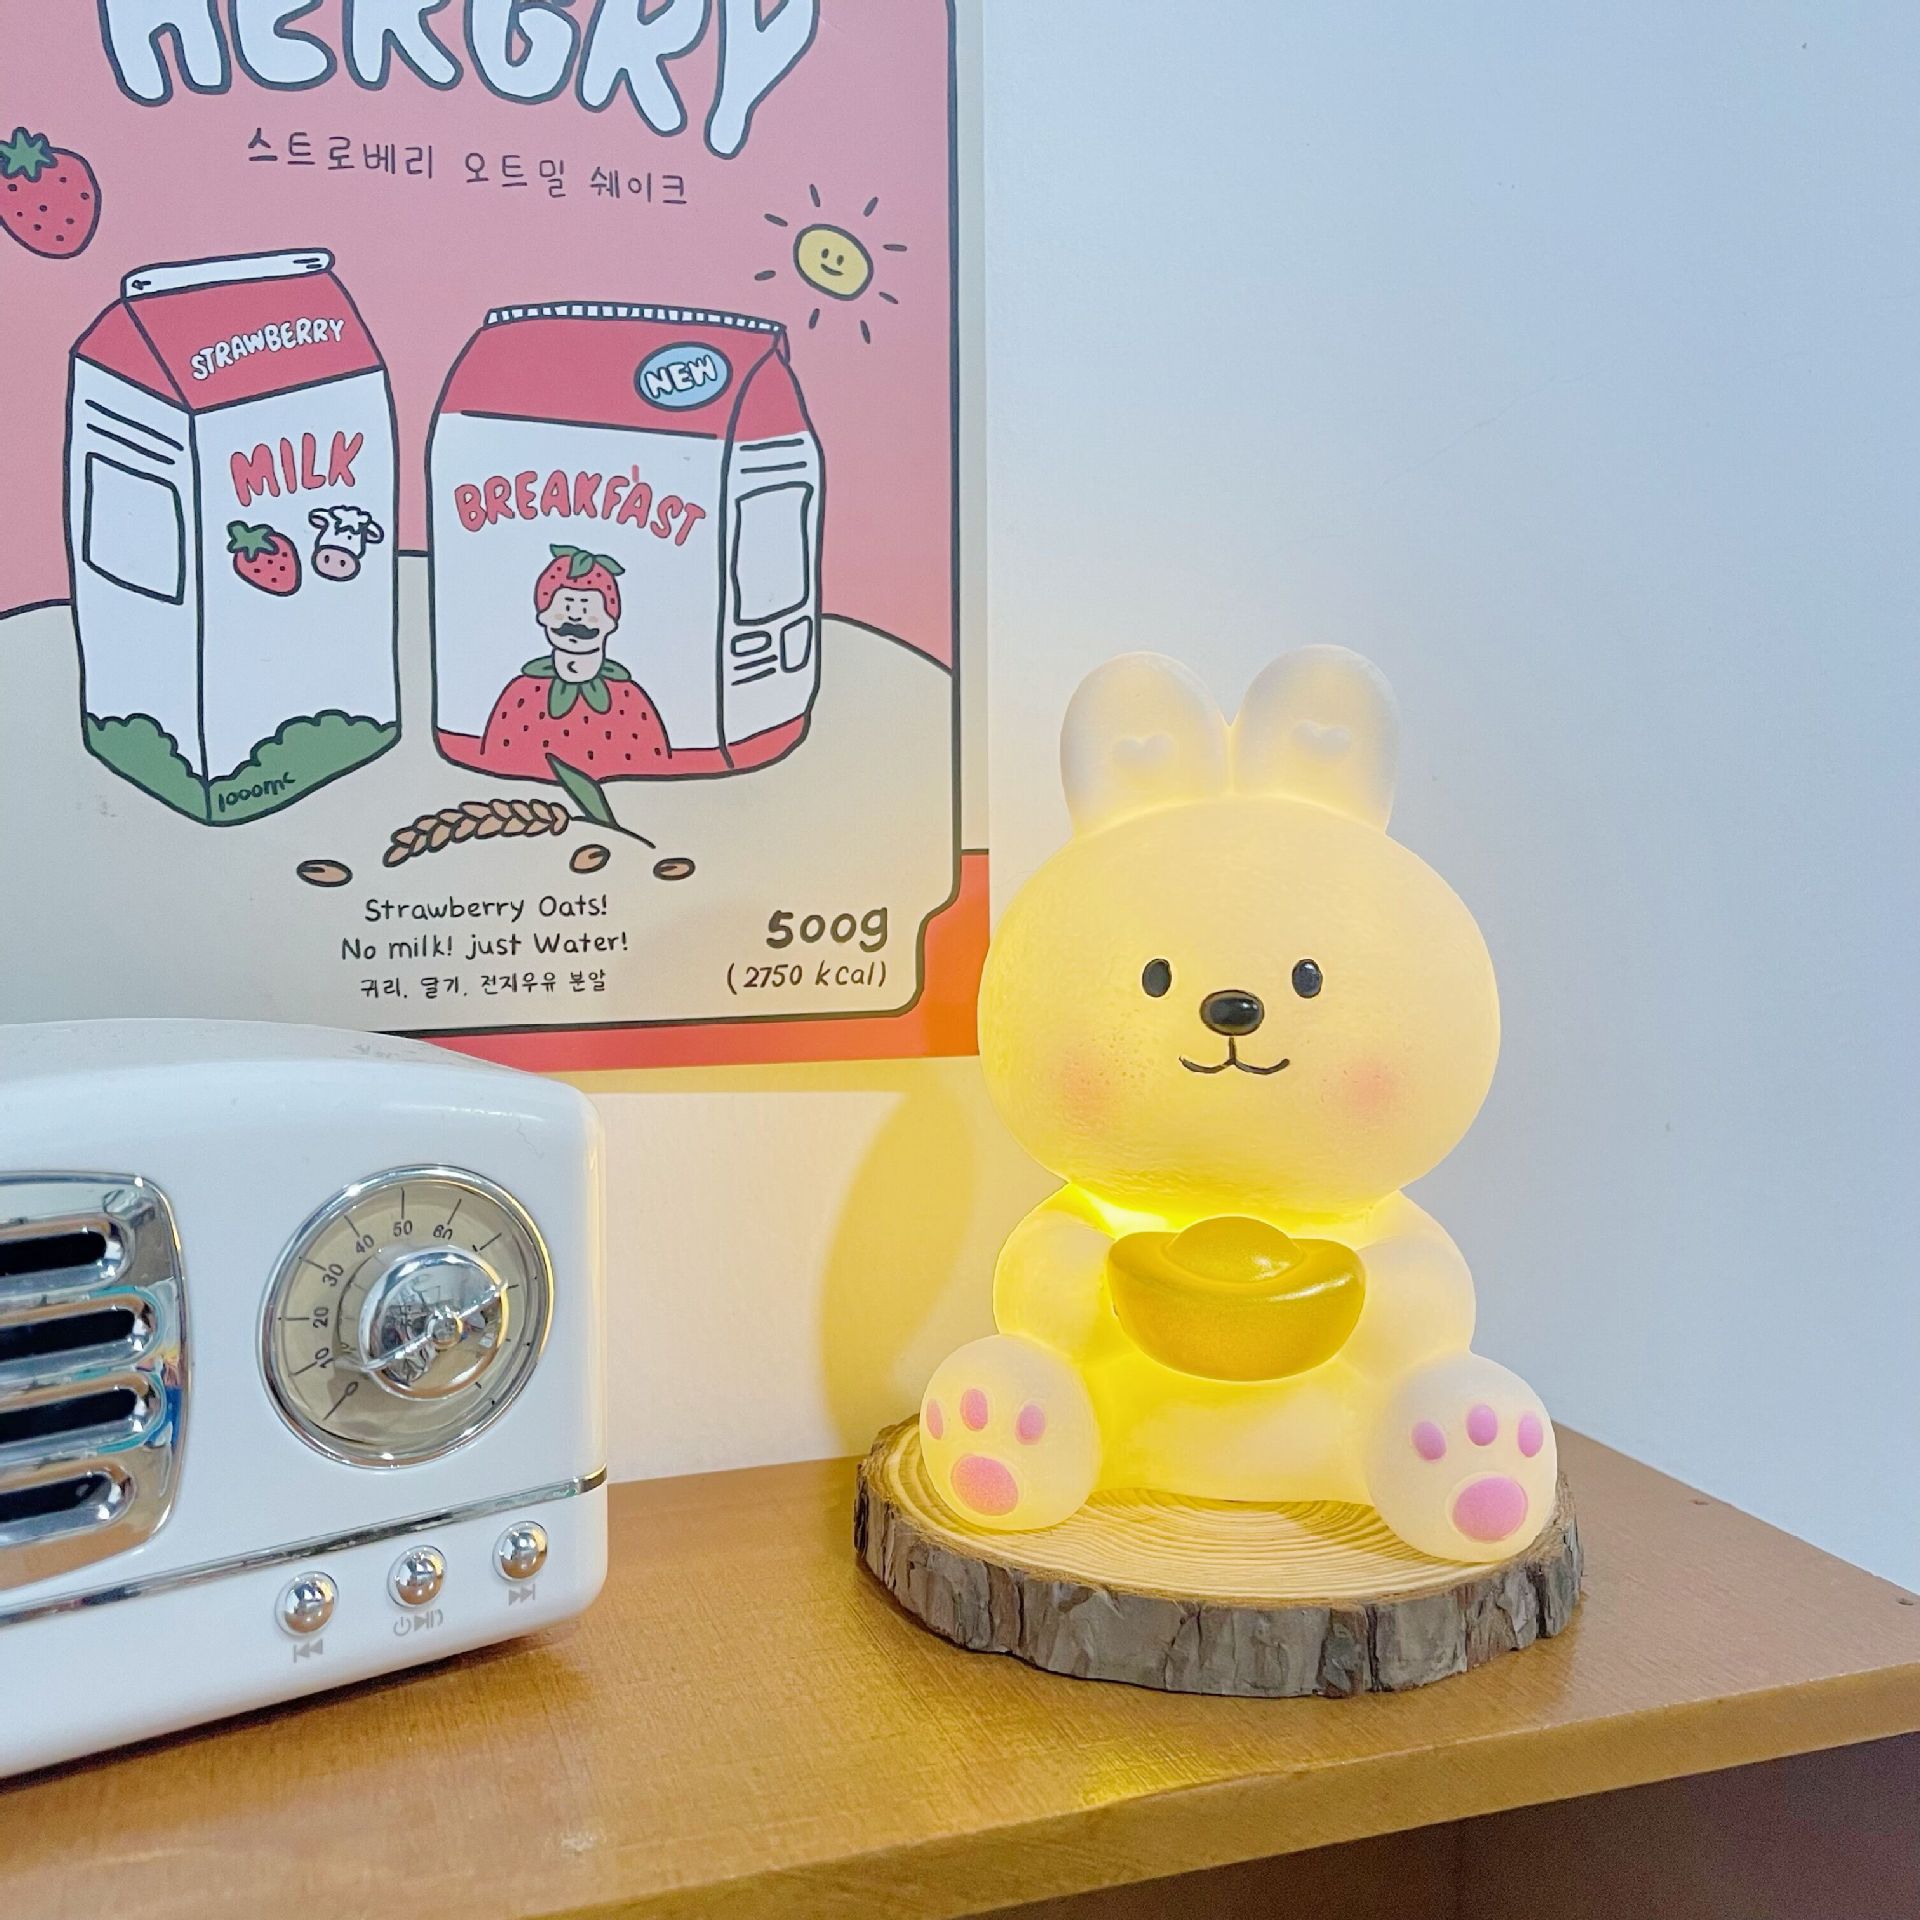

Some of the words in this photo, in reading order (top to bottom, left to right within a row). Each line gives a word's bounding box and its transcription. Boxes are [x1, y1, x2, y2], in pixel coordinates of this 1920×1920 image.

[247, 127, 433, 179] 스트로베리
[464, 152, 567, 198] 오트밀
[590, 166, 688, 204] 쉐이크
[190, 317, 345, 380] STRAWBERRY
[644, 354, 718, 399] NEW
[229, 430, 364, 507] MILK
[454, 467, 707, 546] BREAKFAST
[364, 896, 525, 922] Strawberry
[538, 894, 608, 917] Oats!
[766, 906, 888, 953] 500g
[341, 937, 376, 960] No
[388, 934, 453, 958] milk!
[465, 933, 522, 960] just
[533, 931, 629, 954] Water!
[480, 972, 556, 996] 전지우유
[726, 962, 803, 996] (2750
[392, 1219, 413, 1238] 50
[355, 1234, 375, 1254] 40
[322, 1263, 345, 1287] 30
[312, 1306, 329, 1330] 20
[314, 1346, 336, 1370] 10
